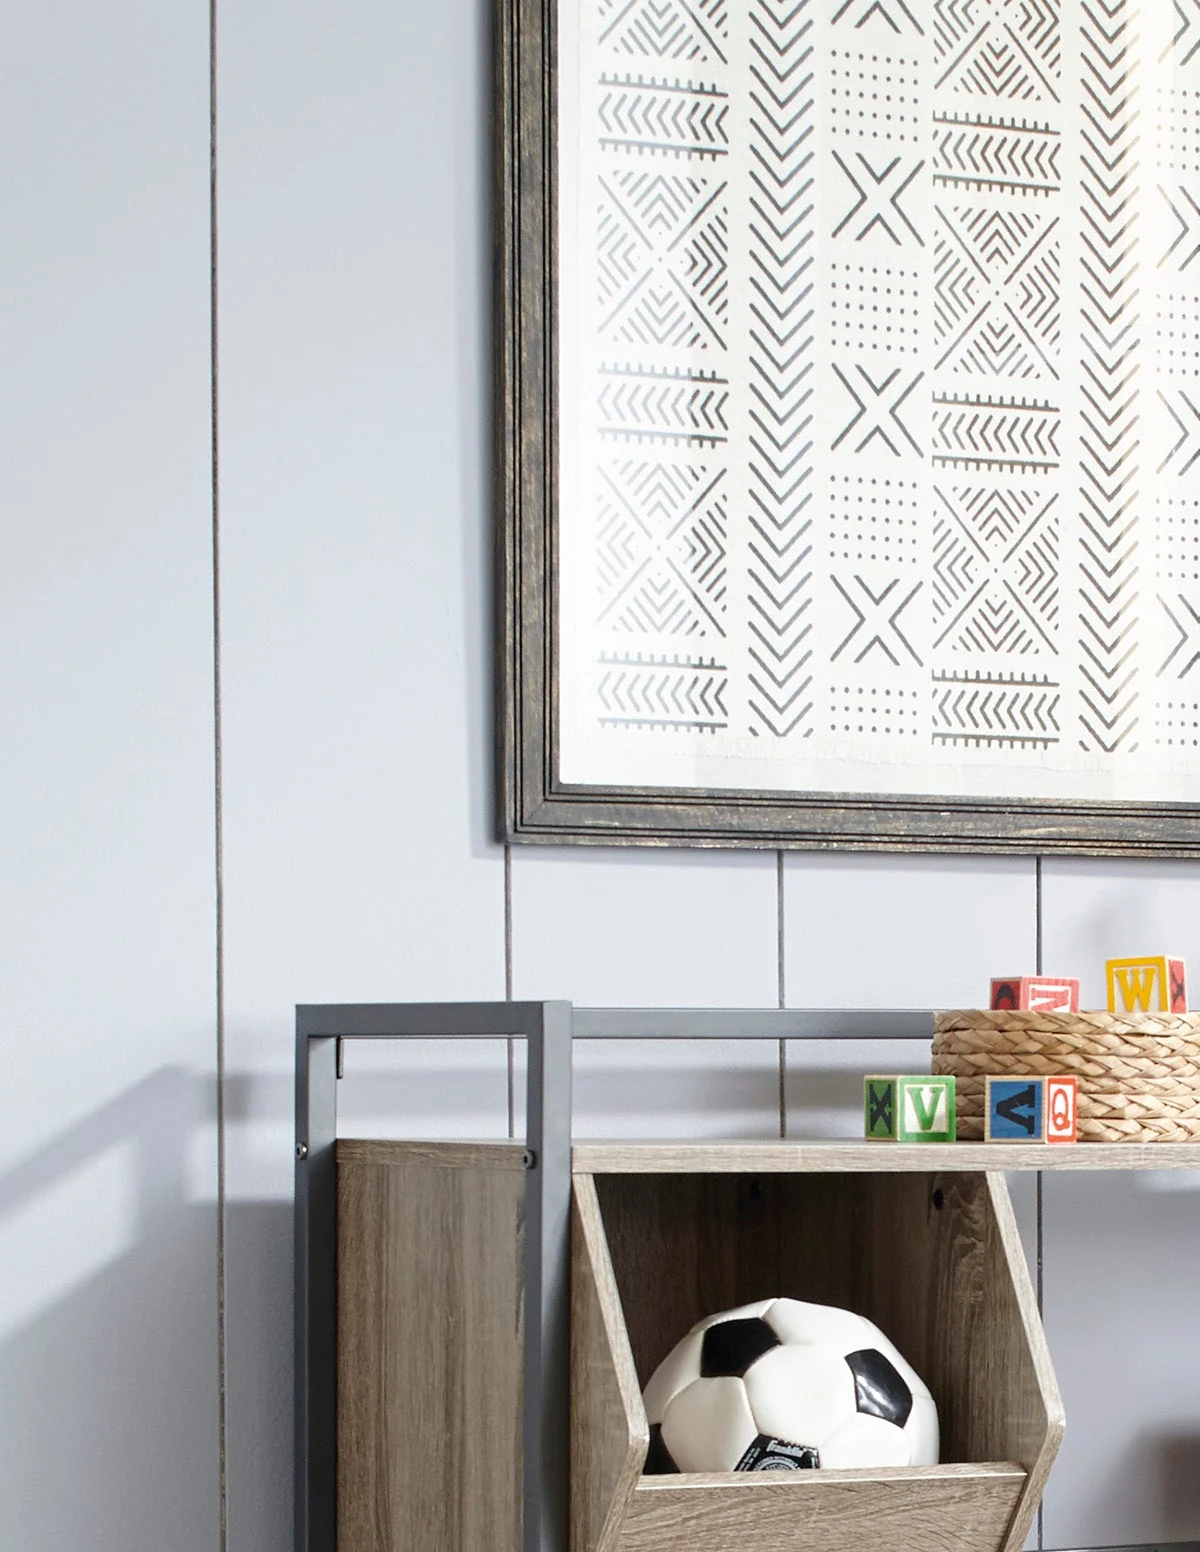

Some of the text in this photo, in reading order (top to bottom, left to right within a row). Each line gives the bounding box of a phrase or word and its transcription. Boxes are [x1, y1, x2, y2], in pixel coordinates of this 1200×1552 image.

[1114, 966, 1157, 1013] W
[907, 1087, 945, 1131] V
[1052, 1088, 1071, 1131] Q
